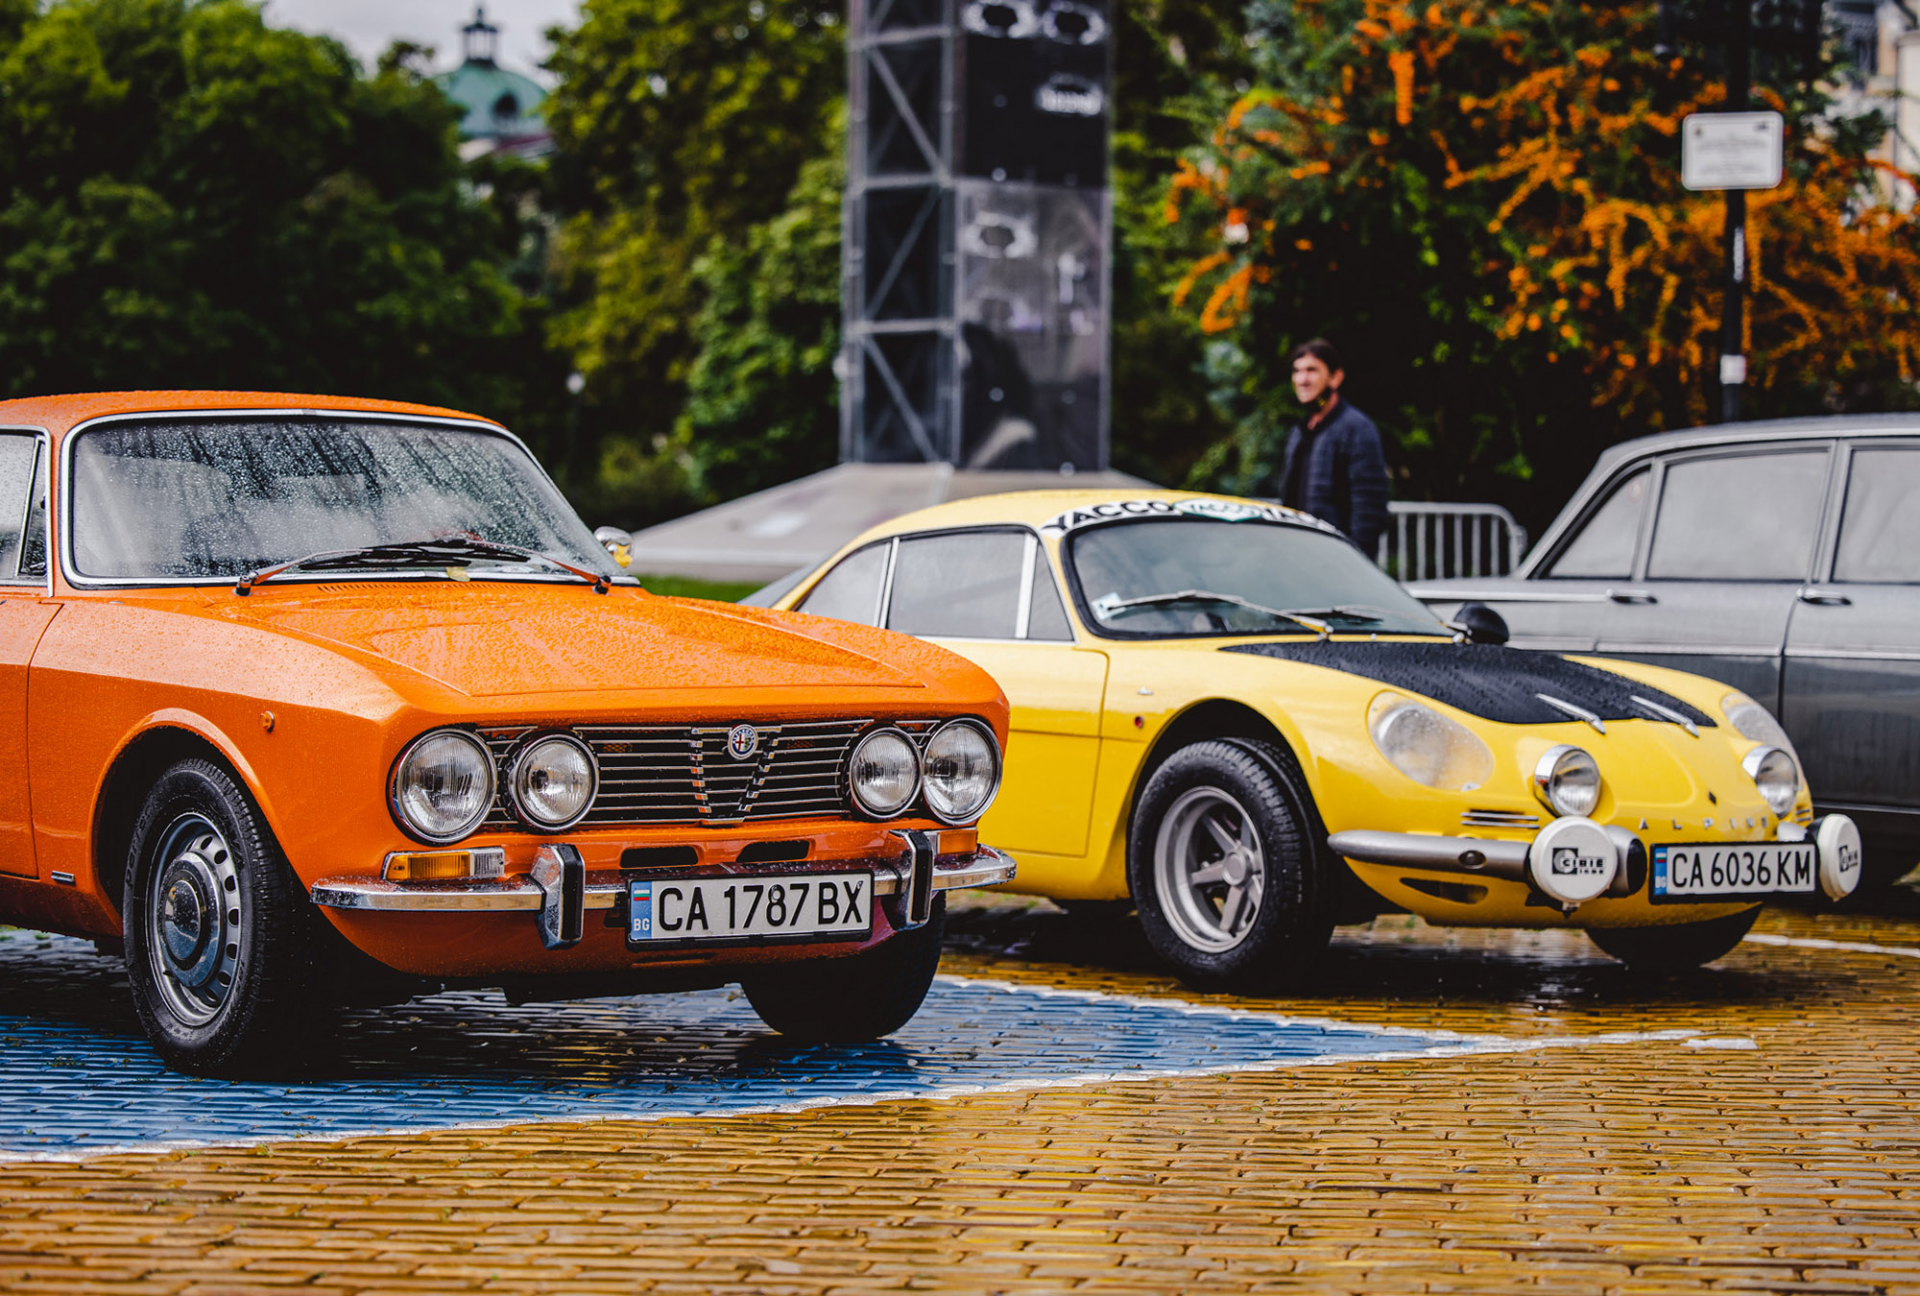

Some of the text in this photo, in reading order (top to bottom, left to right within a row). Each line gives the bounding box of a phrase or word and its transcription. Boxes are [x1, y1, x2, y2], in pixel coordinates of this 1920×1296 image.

[1042, 500, 1174, 531] YACCO
[1672, 852, 1704, 888] CA
[1710, 851, 1771, 887] 6036
[1777, 850, 1811, 886] KM
[658, 880, 864, 931] CA 1787 BX
[633, 918, 650, 932] BG
